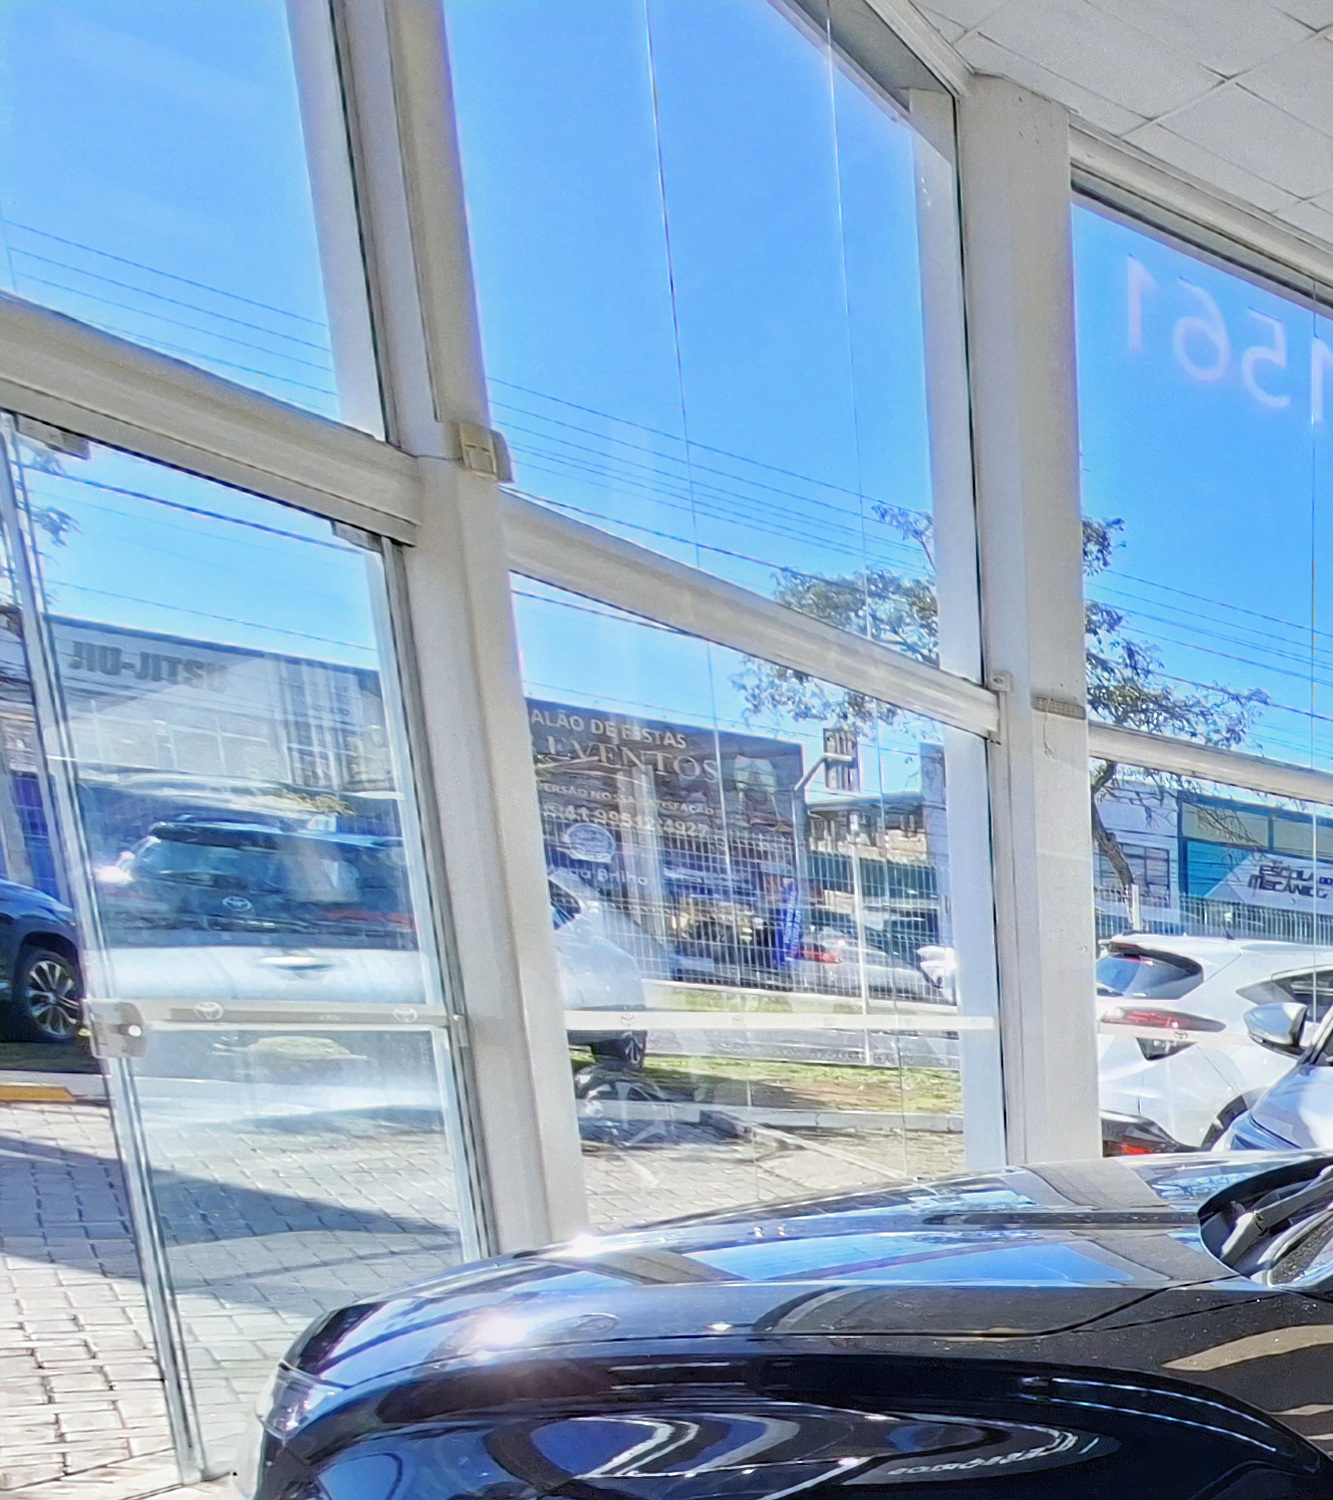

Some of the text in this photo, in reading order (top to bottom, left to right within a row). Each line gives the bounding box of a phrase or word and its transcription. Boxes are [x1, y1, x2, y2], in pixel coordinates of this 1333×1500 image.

[69, 641, 228, 693] JIU-JITSU
[530, 708, 687, 750] ALÃO DE FESTAS
[546, 734, 718, 784] EVENTOS
